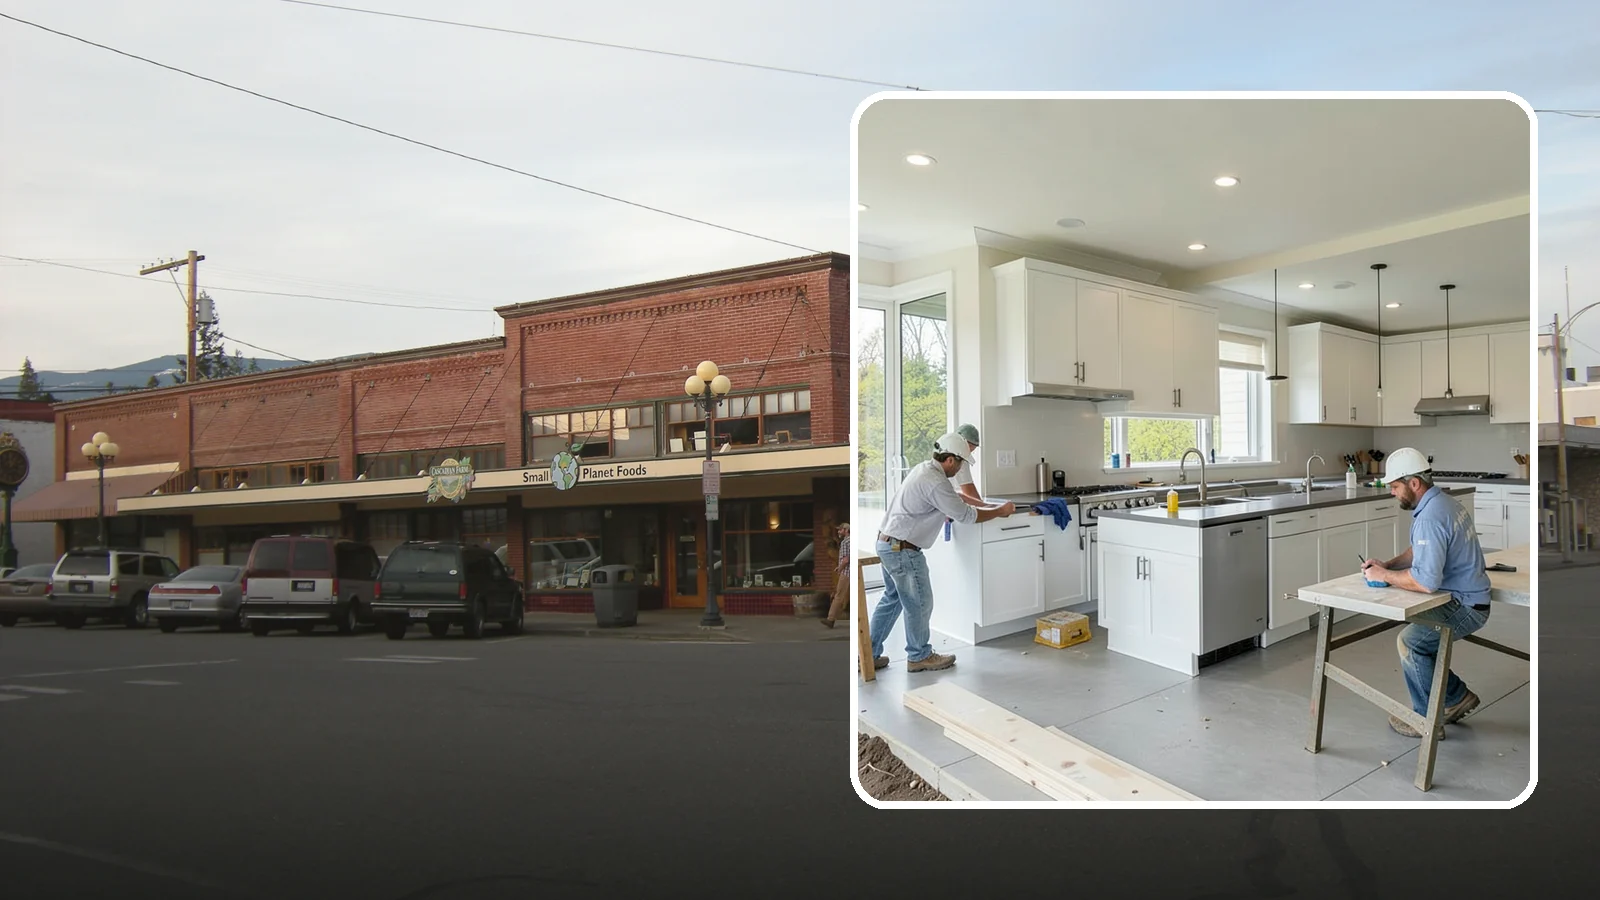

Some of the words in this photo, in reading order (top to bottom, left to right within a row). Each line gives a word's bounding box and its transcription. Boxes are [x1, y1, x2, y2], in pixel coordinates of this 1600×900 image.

[523, 470, 549, 483] Small
[582, 467, 614, 479] Planet
[616, 464, 647, 477] Foods
